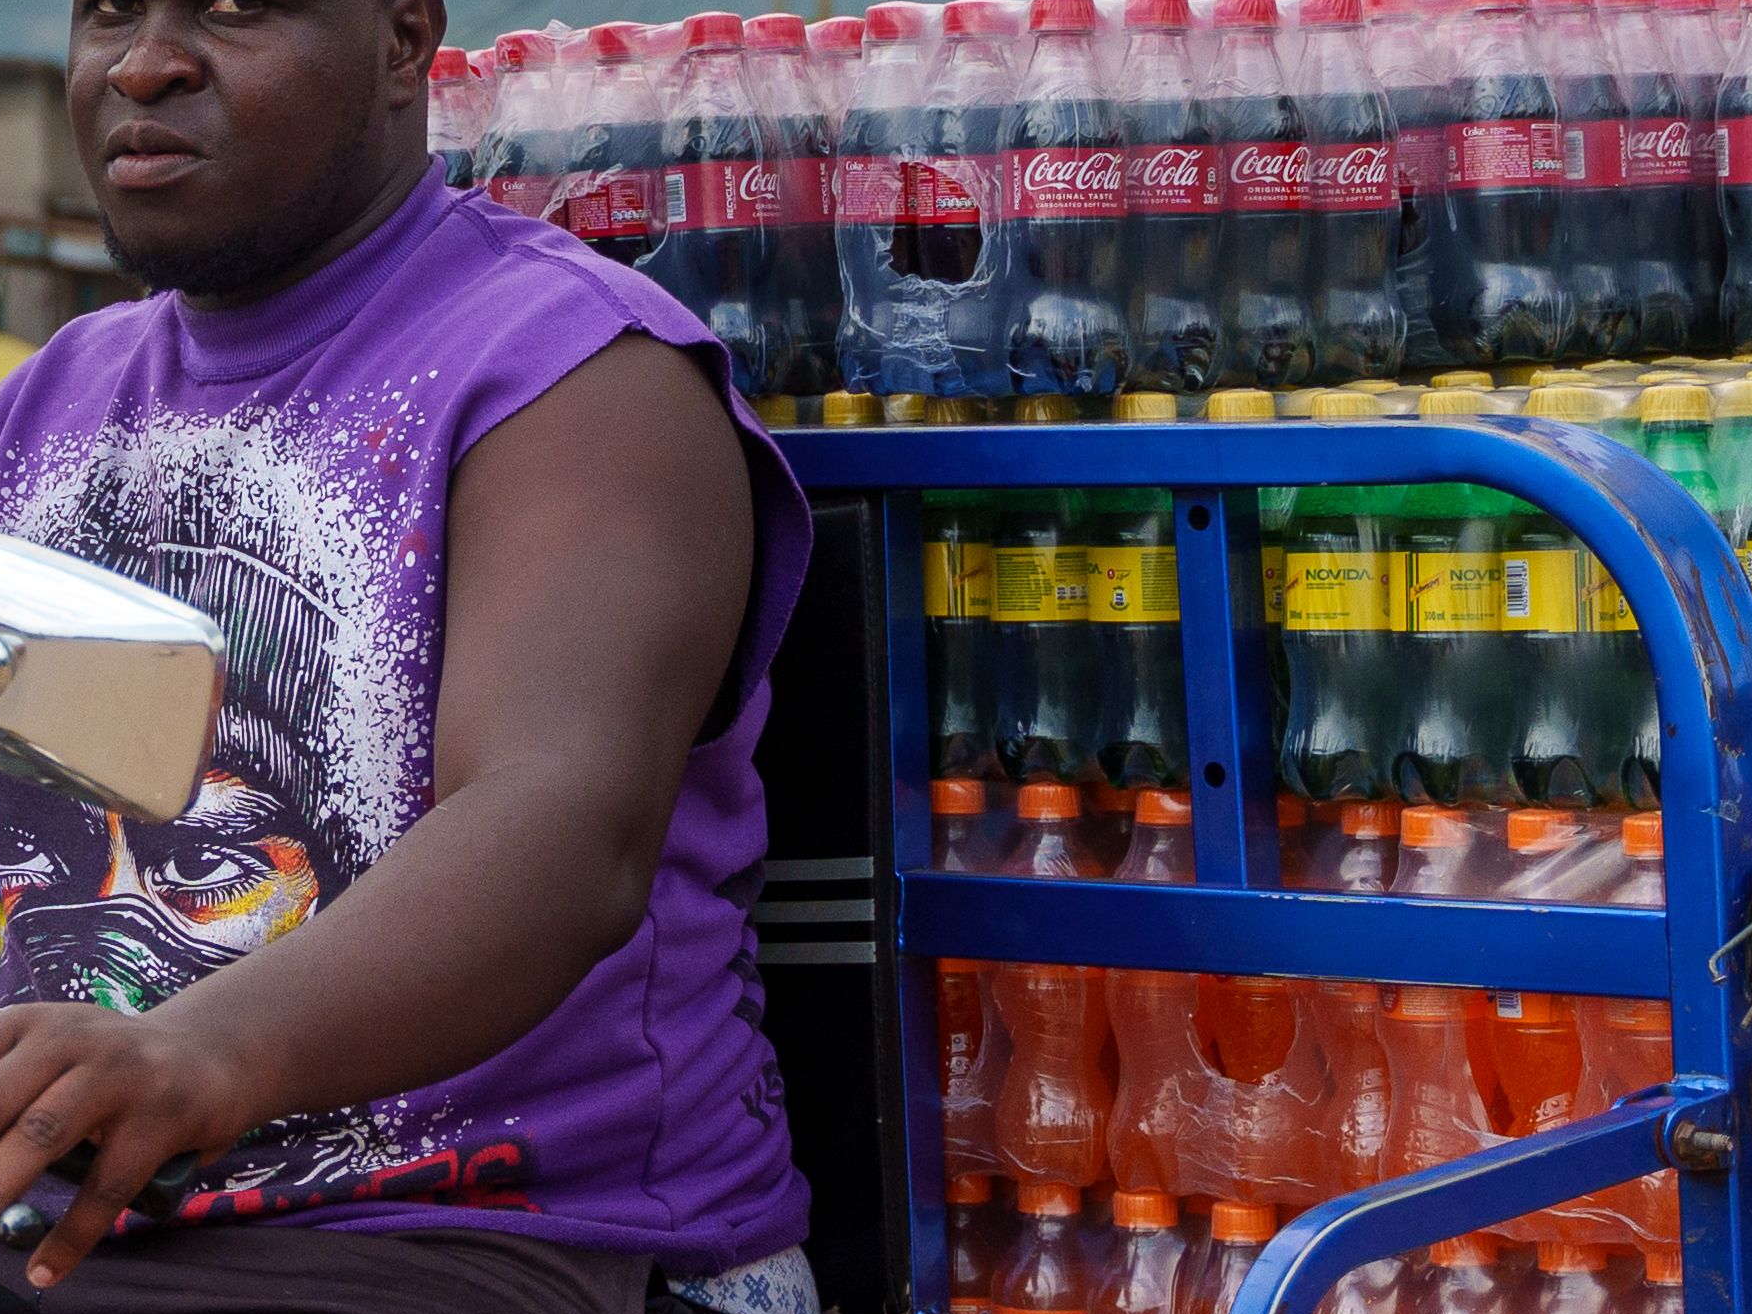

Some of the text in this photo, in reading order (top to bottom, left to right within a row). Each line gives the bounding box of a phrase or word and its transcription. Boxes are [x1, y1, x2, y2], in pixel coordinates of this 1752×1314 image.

[1024, 152, 1123, 191] Coca-Cola
[1304, 567, 1372, 582] NOVIDA
[1450, 567, 1502, 582] NOVID
